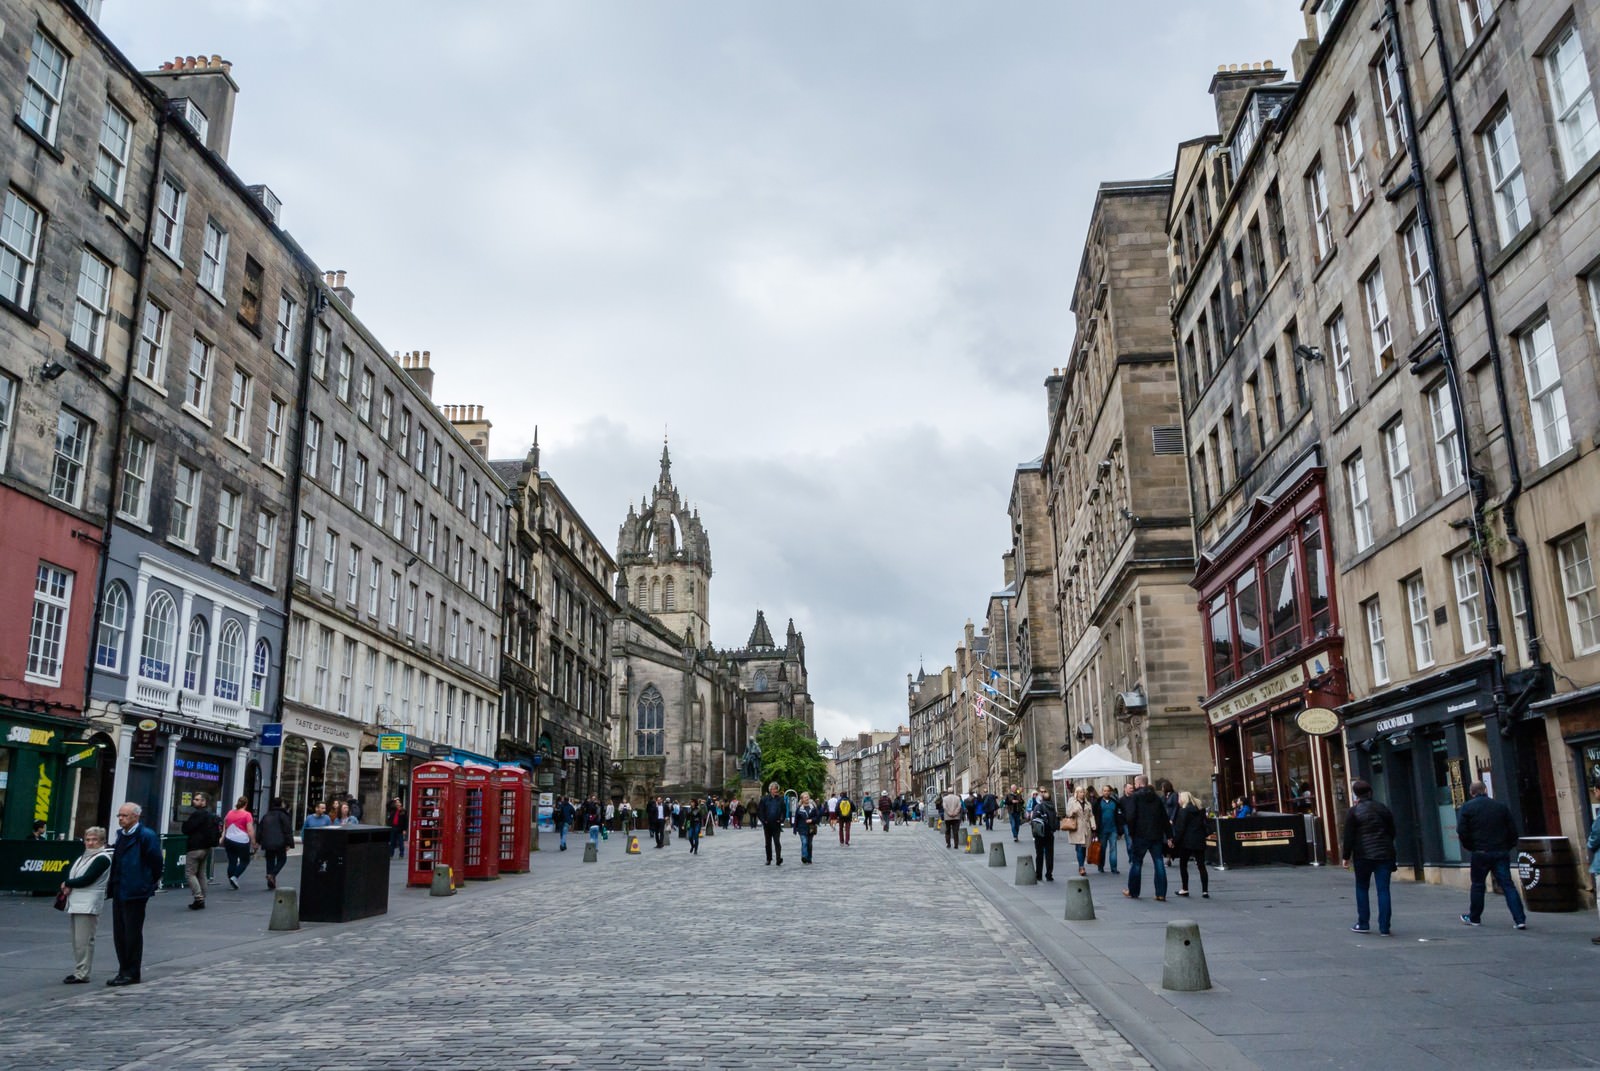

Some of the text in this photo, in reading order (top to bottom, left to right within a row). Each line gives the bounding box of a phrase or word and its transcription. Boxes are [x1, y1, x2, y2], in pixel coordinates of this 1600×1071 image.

[1220, 704, 1232, 717] THE
[1233, 692, 1258, 710] FILLING
[1259, 678, 1288, 699] STATION
[6, 725, 55, 746] SUBWAY
[160, 722, 174, 734] BAY
[180, 726, 189, 737] OF
[194, 729, 223, 744] BENGAL
[295, 718, 350, 739] TASTE OF SCOTLAND
[66, 746, 96, 766] SUBWAY
[186, 761, 195, 770] OF
[196, 762, 219, 773] BENGAL
[20, 859, 70, 872] SUBWAY
